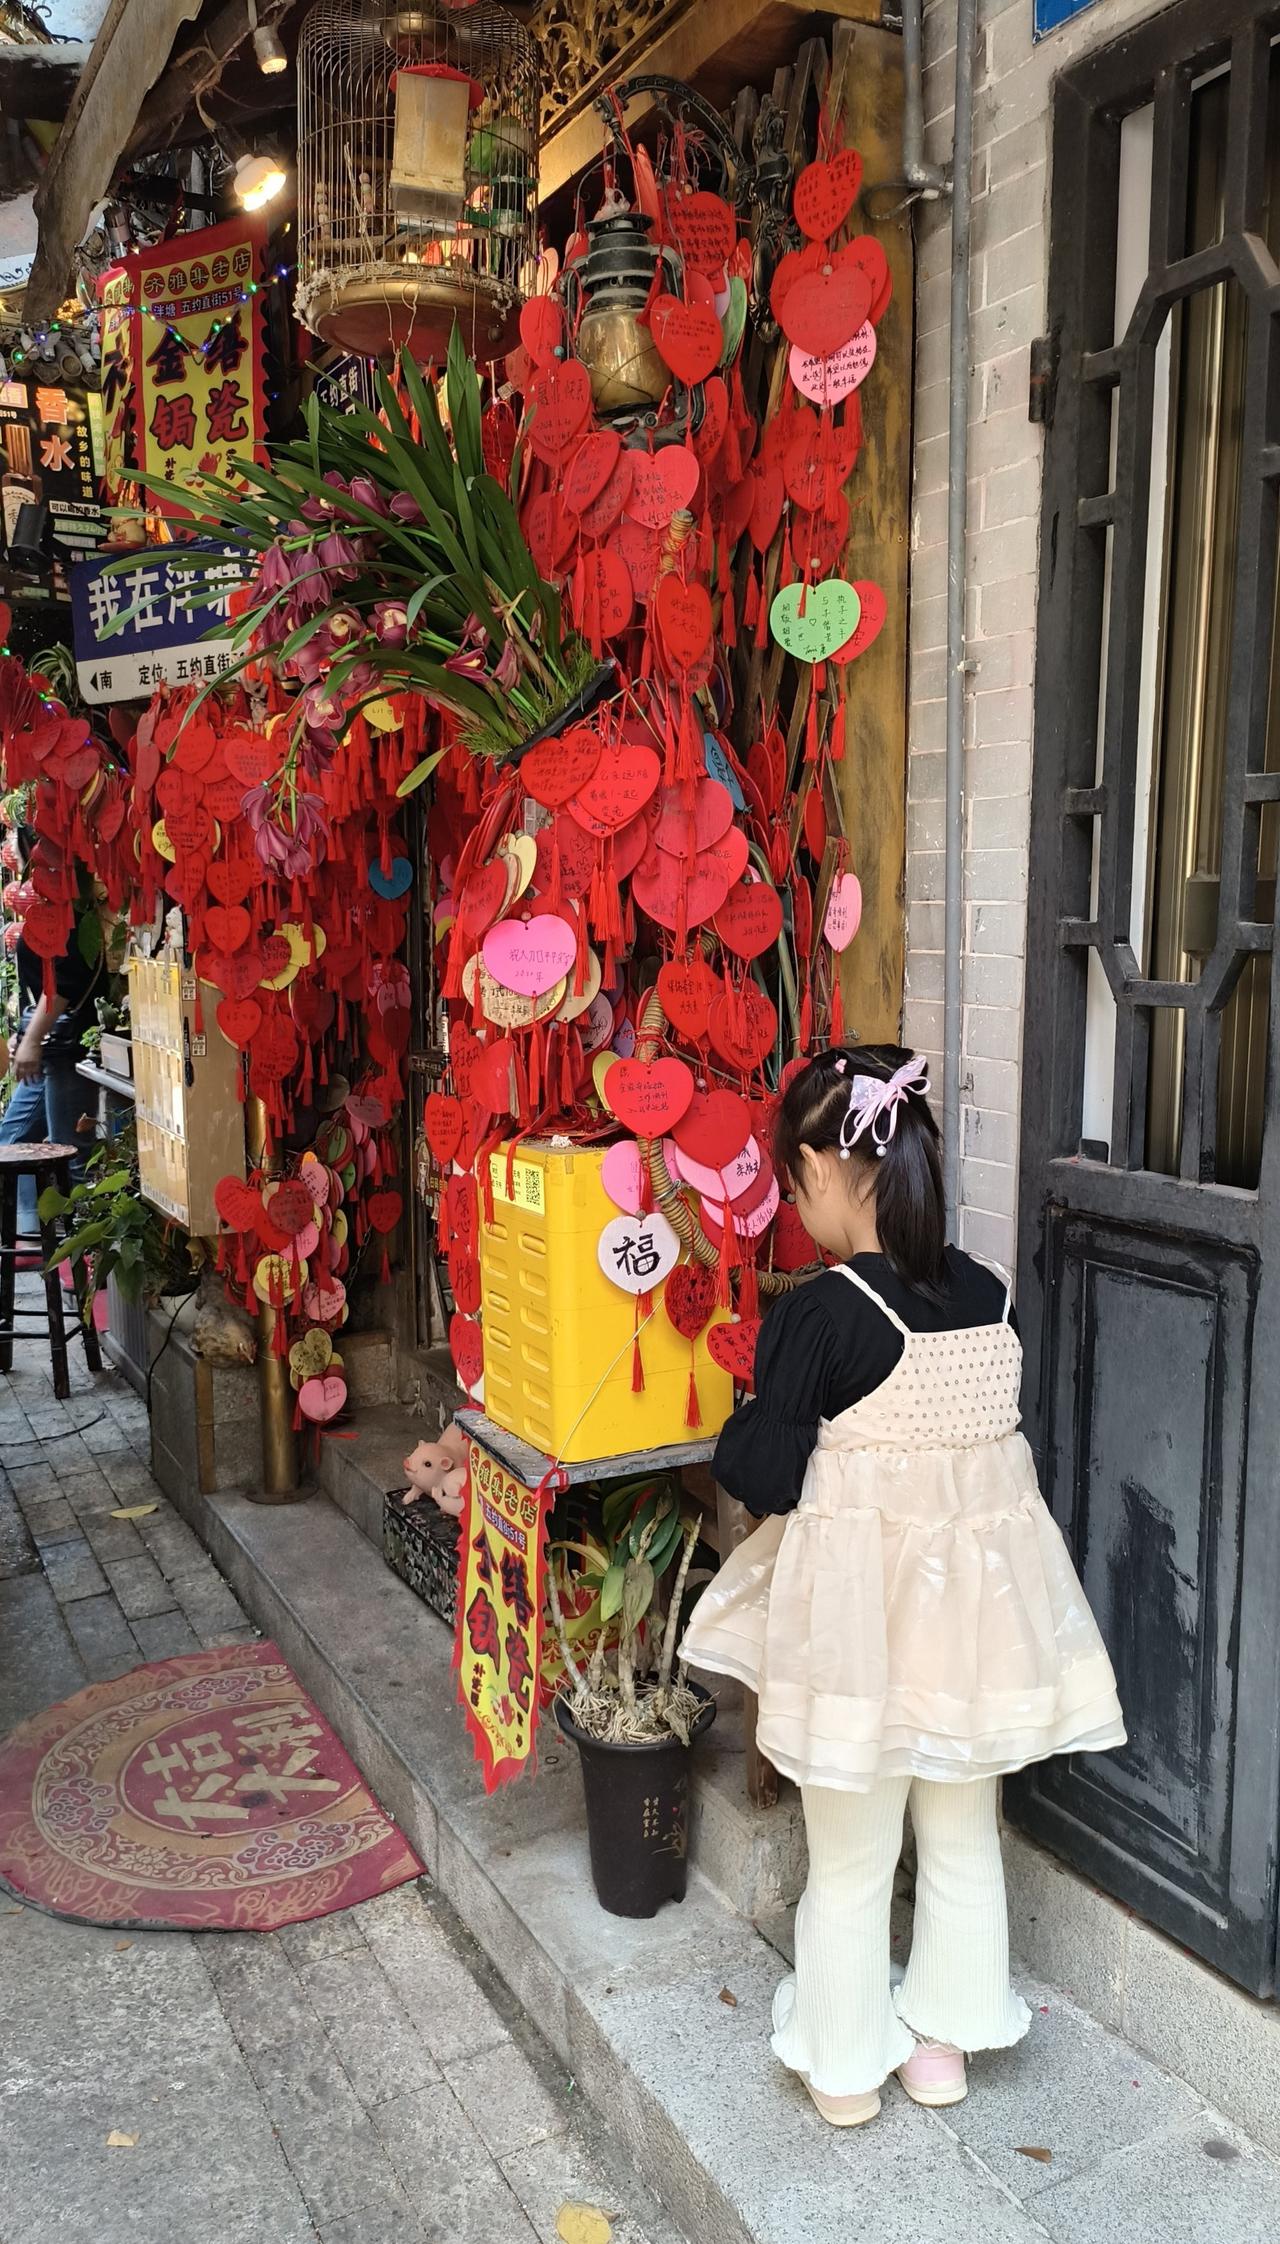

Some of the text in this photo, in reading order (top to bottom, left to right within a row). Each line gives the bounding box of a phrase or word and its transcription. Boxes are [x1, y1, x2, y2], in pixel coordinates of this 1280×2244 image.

[145, 252, 251, 294] 齐雅集老店
[181, 286, 242, 314] 五约直街51号
[76, 425, 94, 499] 故乡的味道
[100, 669, 112, 690] 南
[613, 1233, 662, 1277] 福
